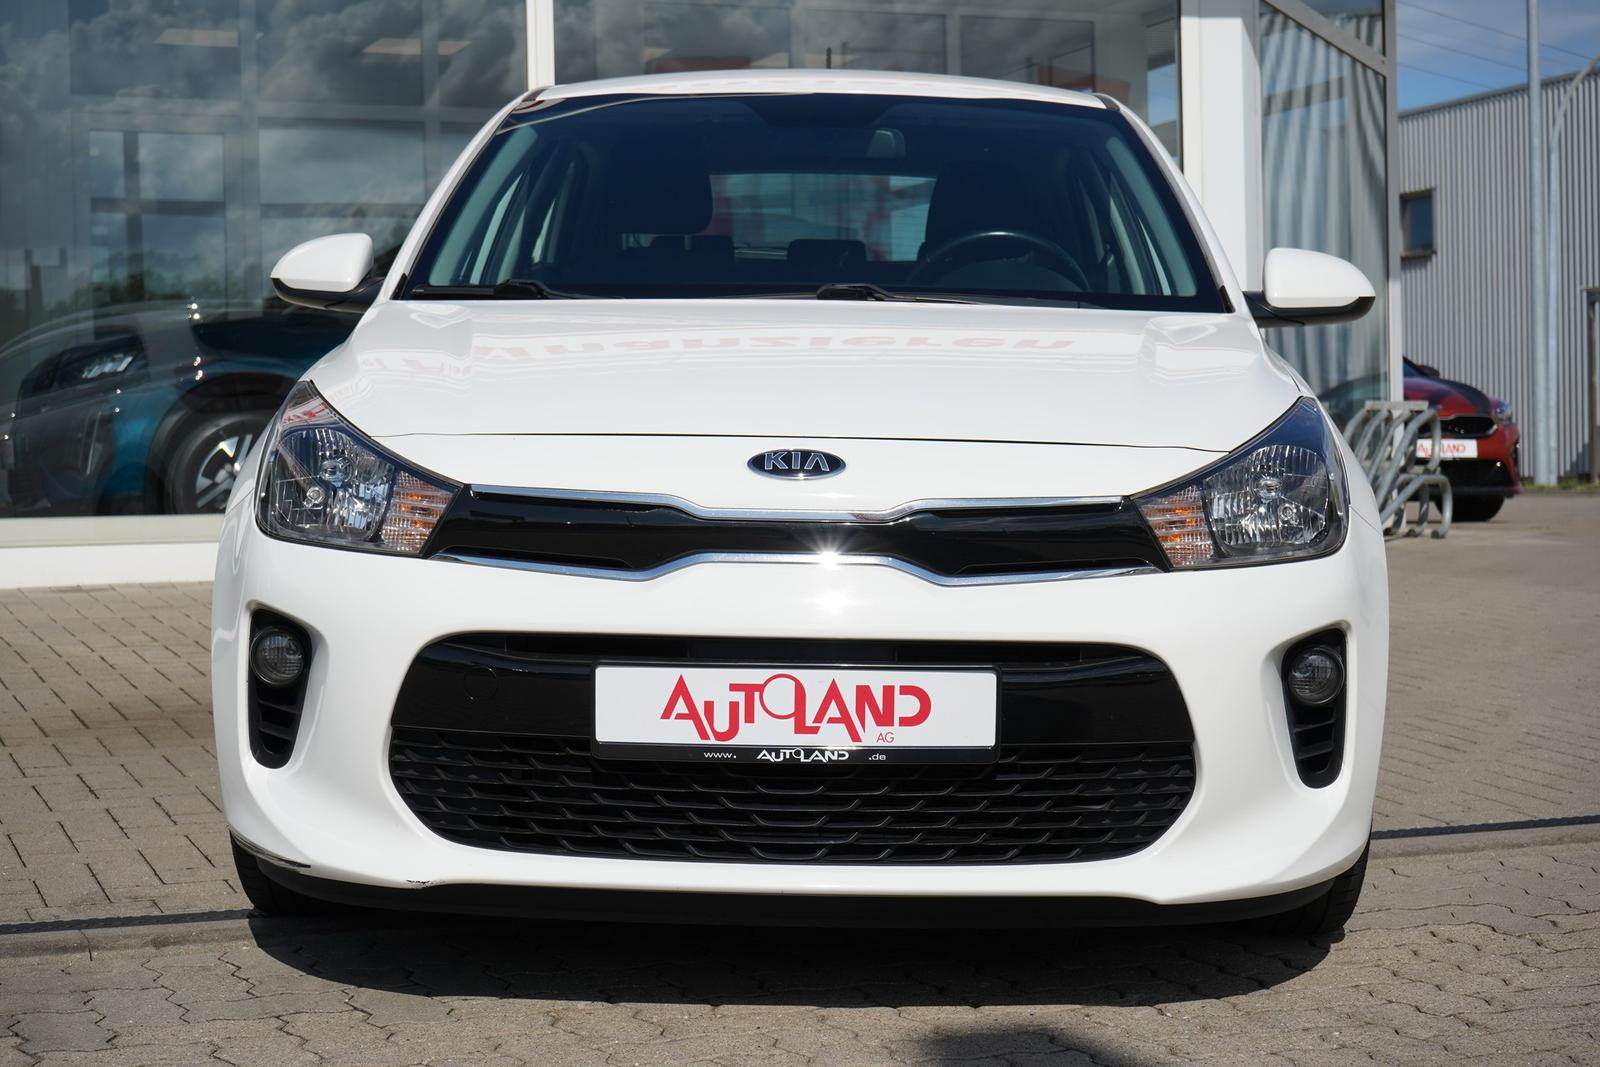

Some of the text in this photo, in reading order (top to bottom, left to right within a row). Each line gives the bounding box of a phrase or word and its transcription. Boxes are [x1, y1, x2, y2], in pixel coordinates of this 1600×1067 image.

[764, 451, 830, 472] KIA
[660, 673, 932, 743] AUTOLAND
[876, 731, 895, 743] AG
[703, 751, 737, 759] www.
[756, 747, 850, 763] AUTOLAND
